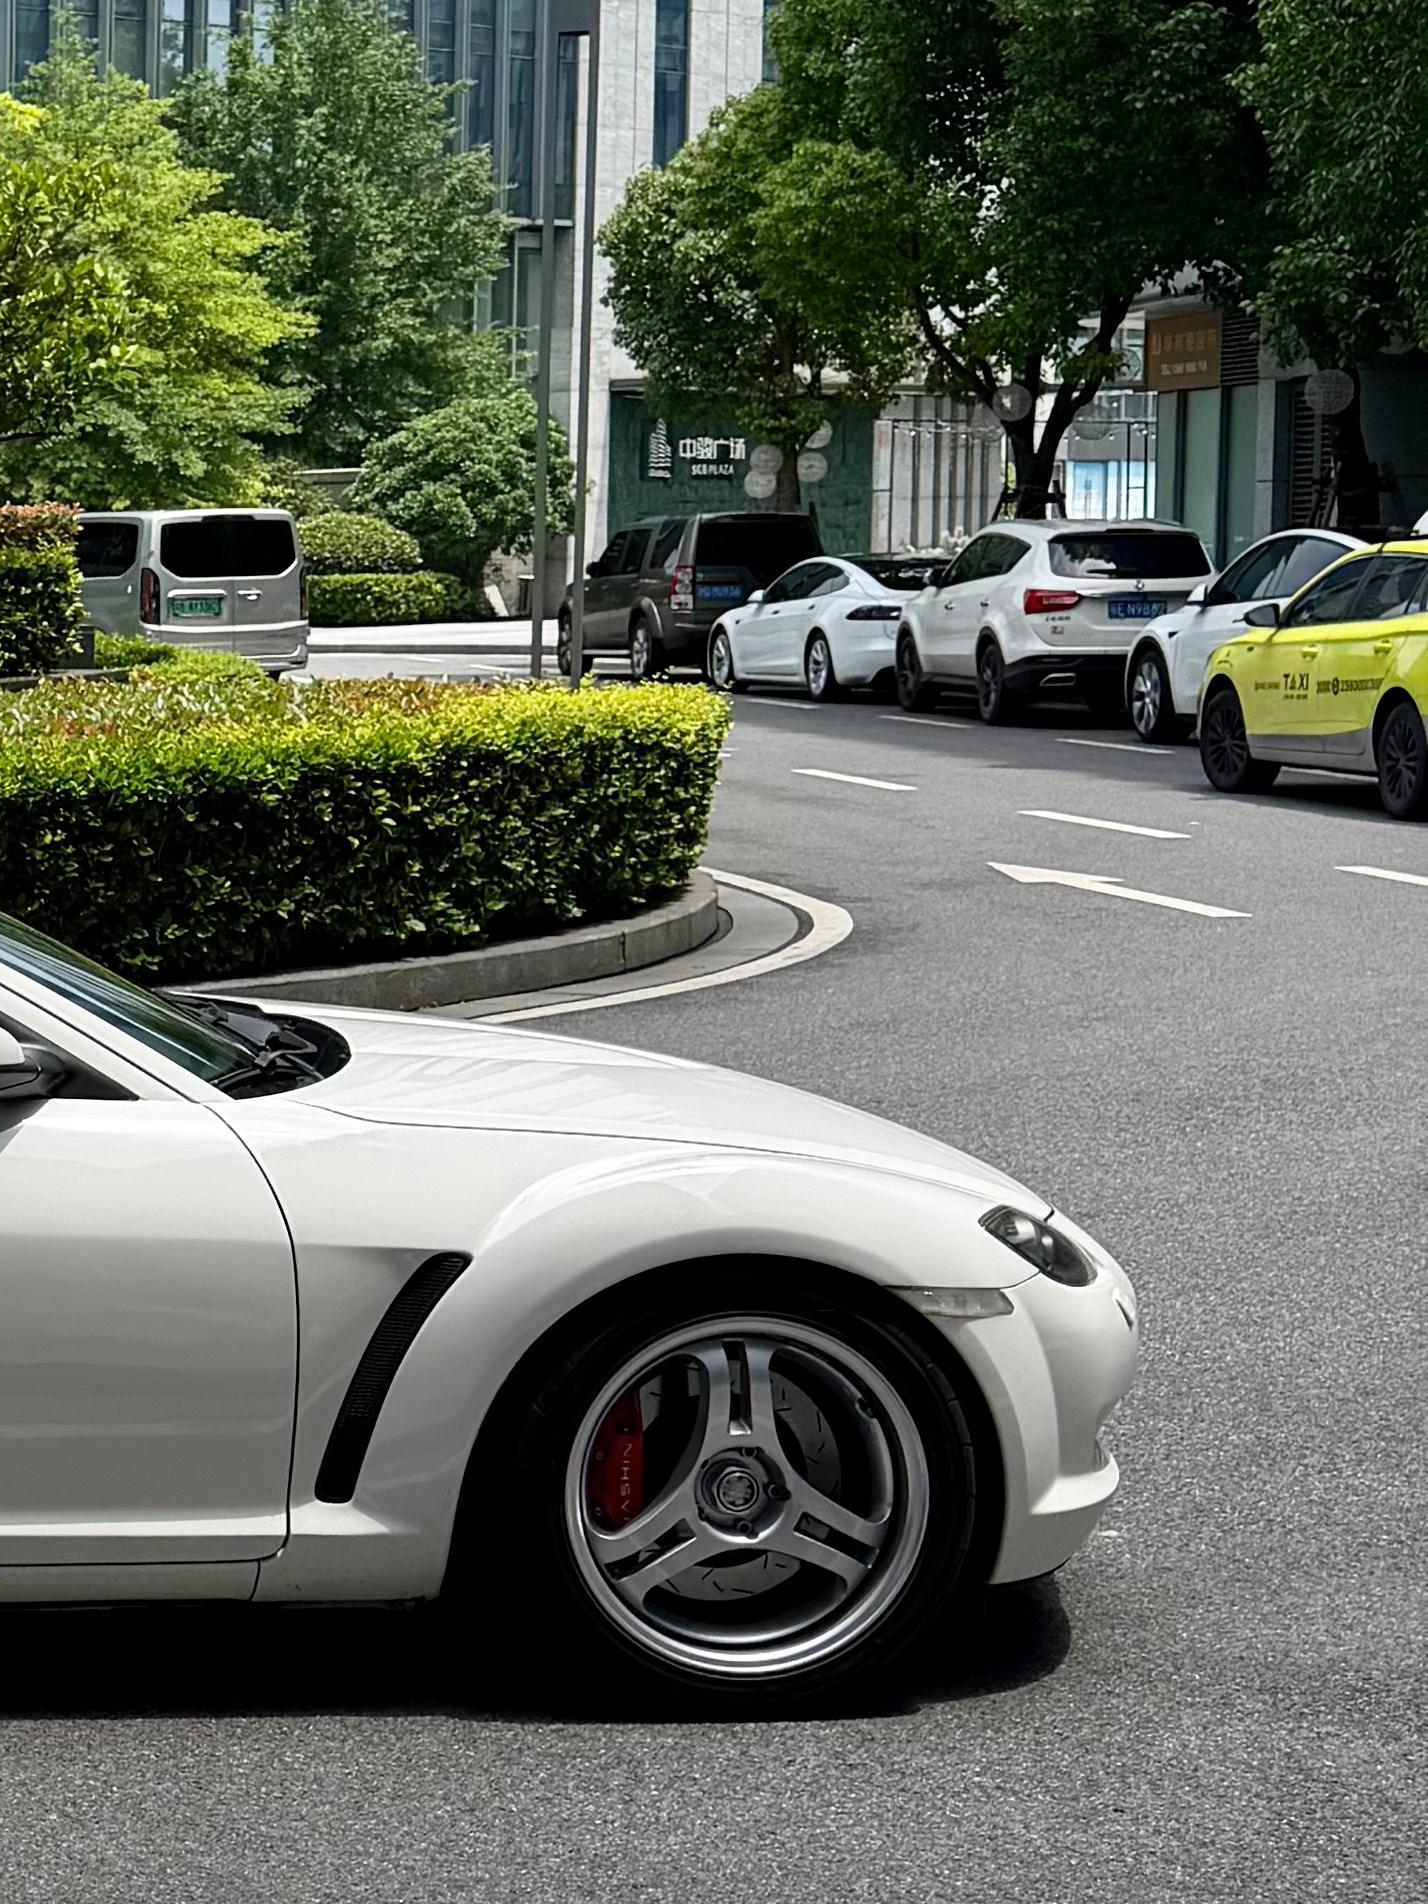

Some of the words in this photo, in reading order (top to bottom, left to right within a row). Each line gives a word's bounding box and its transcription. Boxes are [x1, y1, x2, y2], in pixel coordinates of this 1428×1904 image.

[679, 437, 746, 460] 中骏广场
[708, 463, 734, 475] PLAZA
[1283, 673, 1310, 692] TAXI
